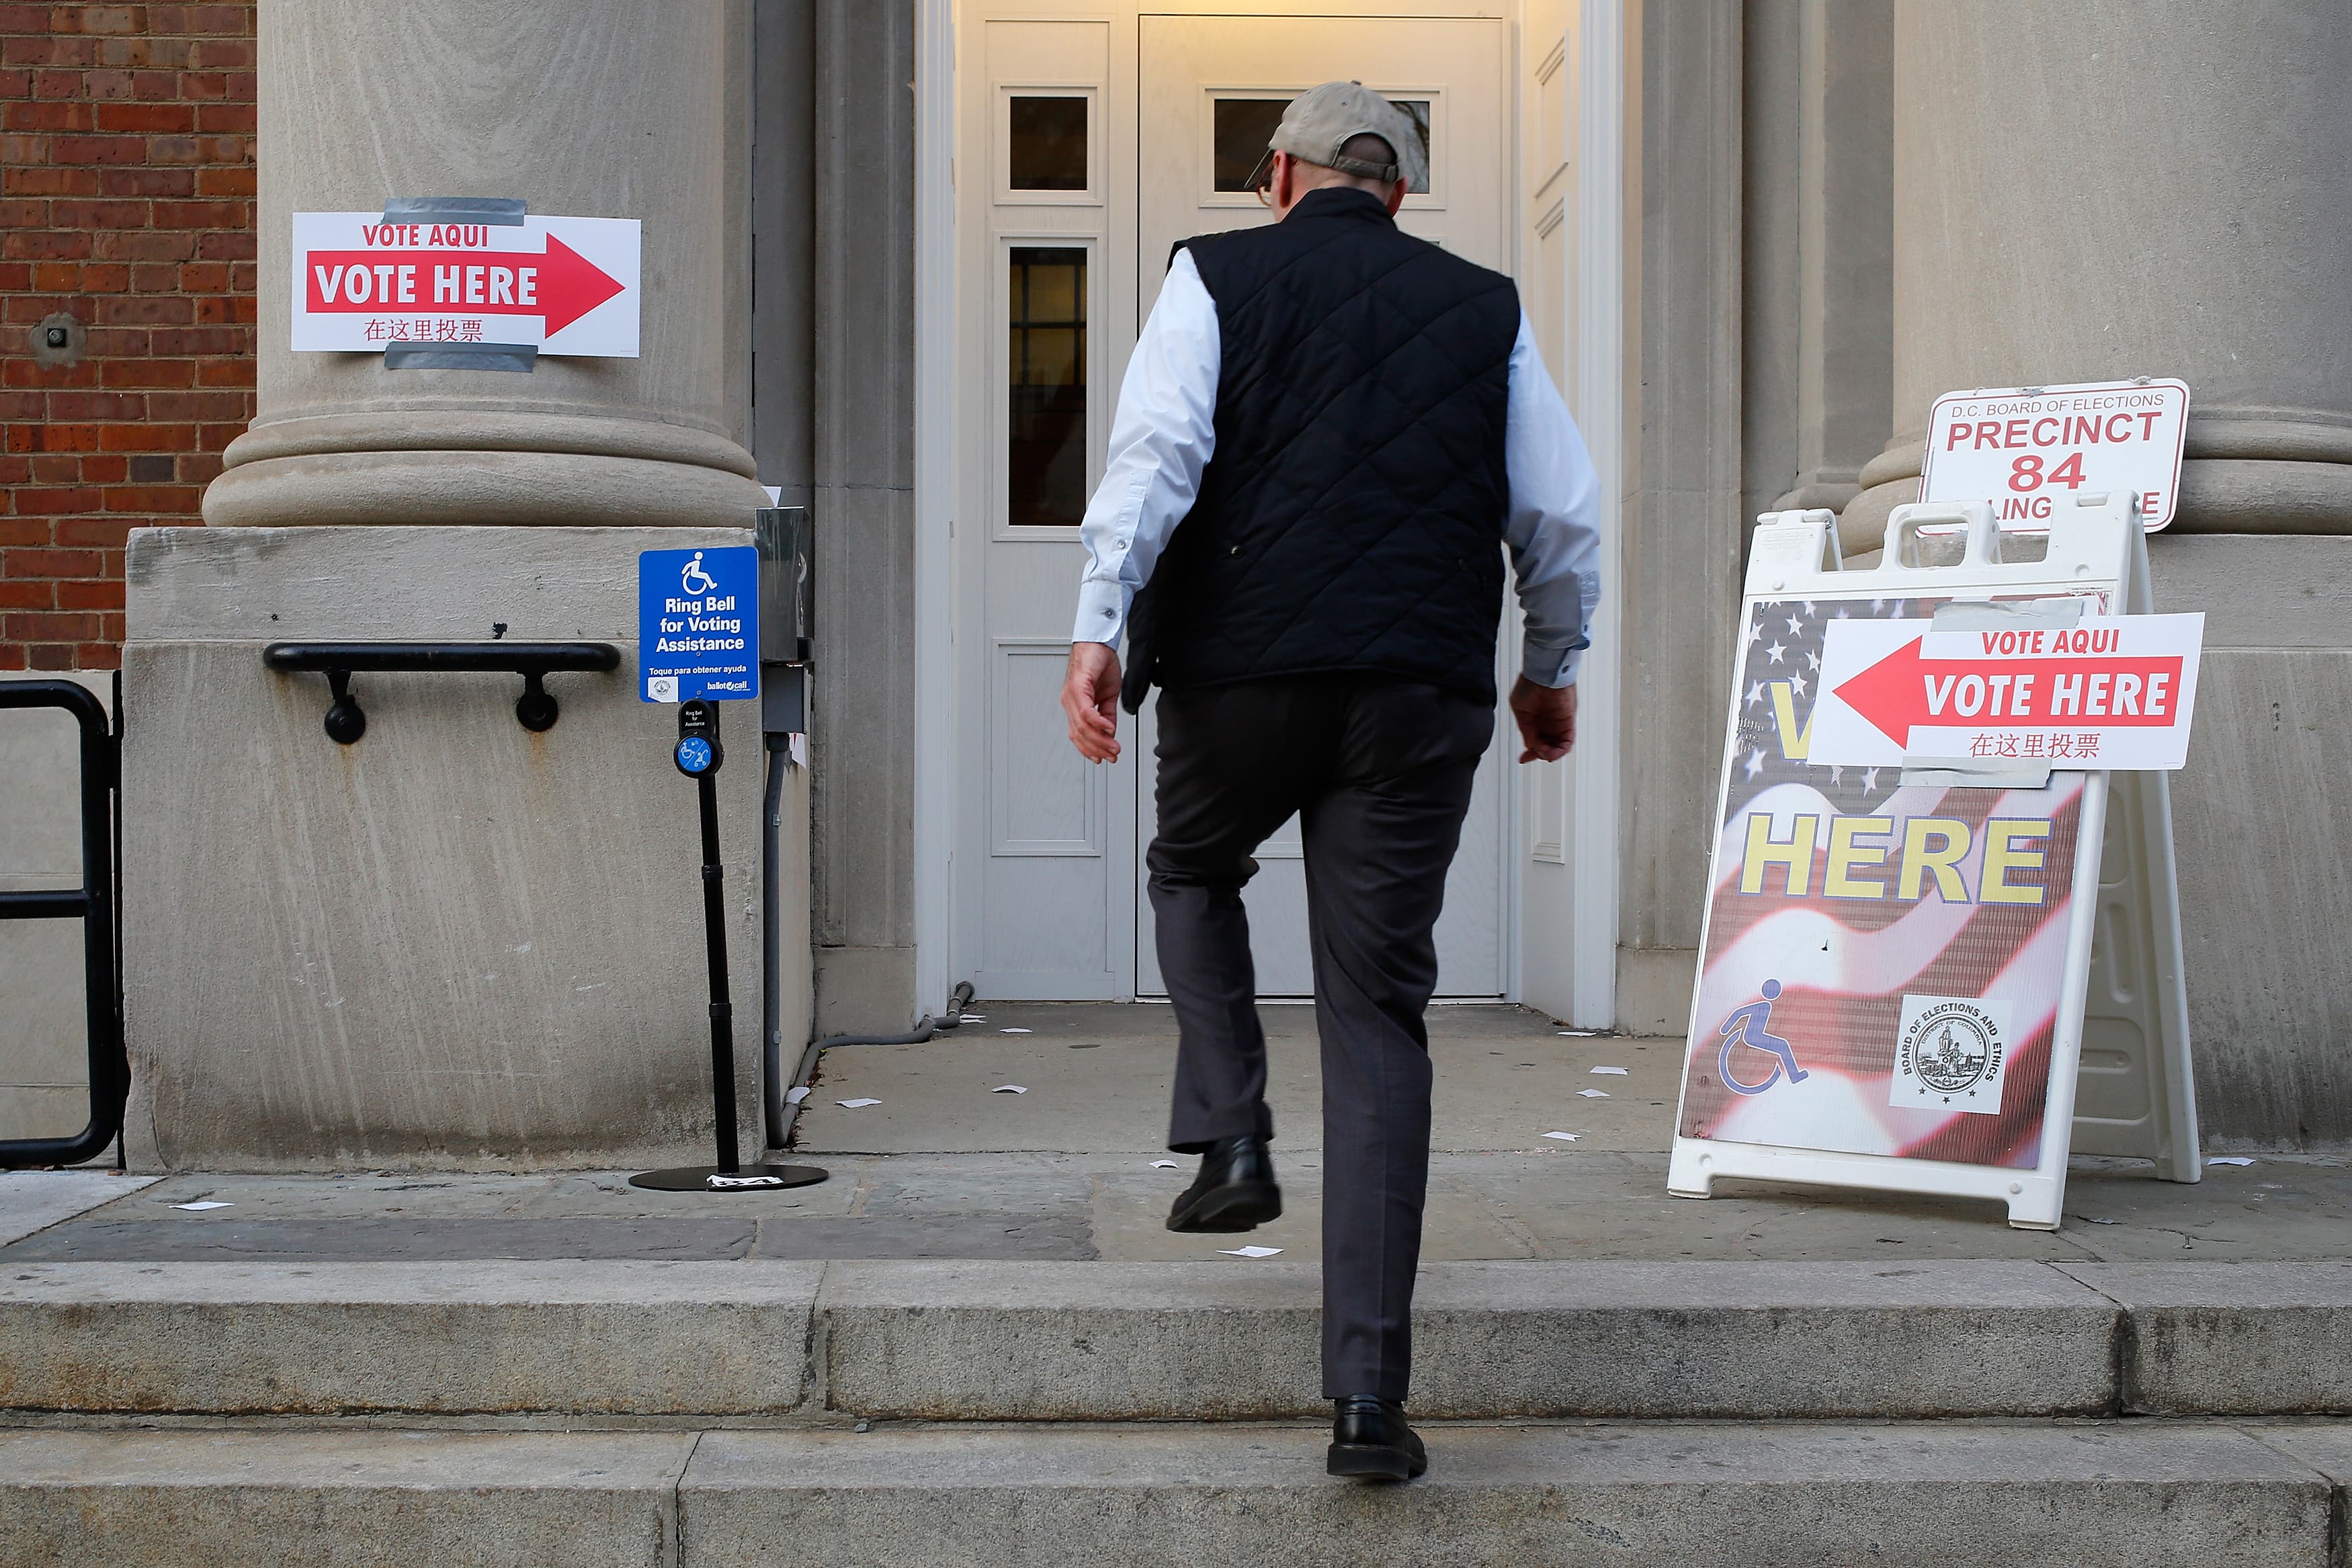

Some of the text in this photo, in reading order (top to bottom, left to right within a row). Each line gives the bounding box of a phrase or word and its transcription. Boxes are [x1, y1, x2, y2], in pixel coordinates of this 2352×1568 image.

[362, 224, 488, 248] VOTE AQUI
[314, 264, 538, 306] VOTE HERE
[364, 318, 483, 343] 在这里投票
[1951, 394, 2165, 418] D.C. BOARD OF ELECTIONS
[1947, 411, 2162, 451] PRECINCT
[2008, 452, 2087, 492] 84
[665, 595, 735, 615] Ring Bell
[660, 615, 741, 634] for Voting
[655, 636, 745, 652] Assistance
[1981, 629, 2119, 655] VOTE AQUI
[648, 664, 747, 677] Toque para obtener ayuda
[1923, 672, 2171, 717] VOTE HERE
[1969, 732, 2102, 759] 在这里投票
[1738, 812, 2053, 906] HERE
[1921, 1002, 1980, 1022] ELECTIONS
[1909, 1019, 1922, 1035] OF
[1980, 1014, 1998, 1037] AND
[1901, 1036, 1913, 1076] BOARD
[1984, 1042, 2003, 1082] ETHICS
